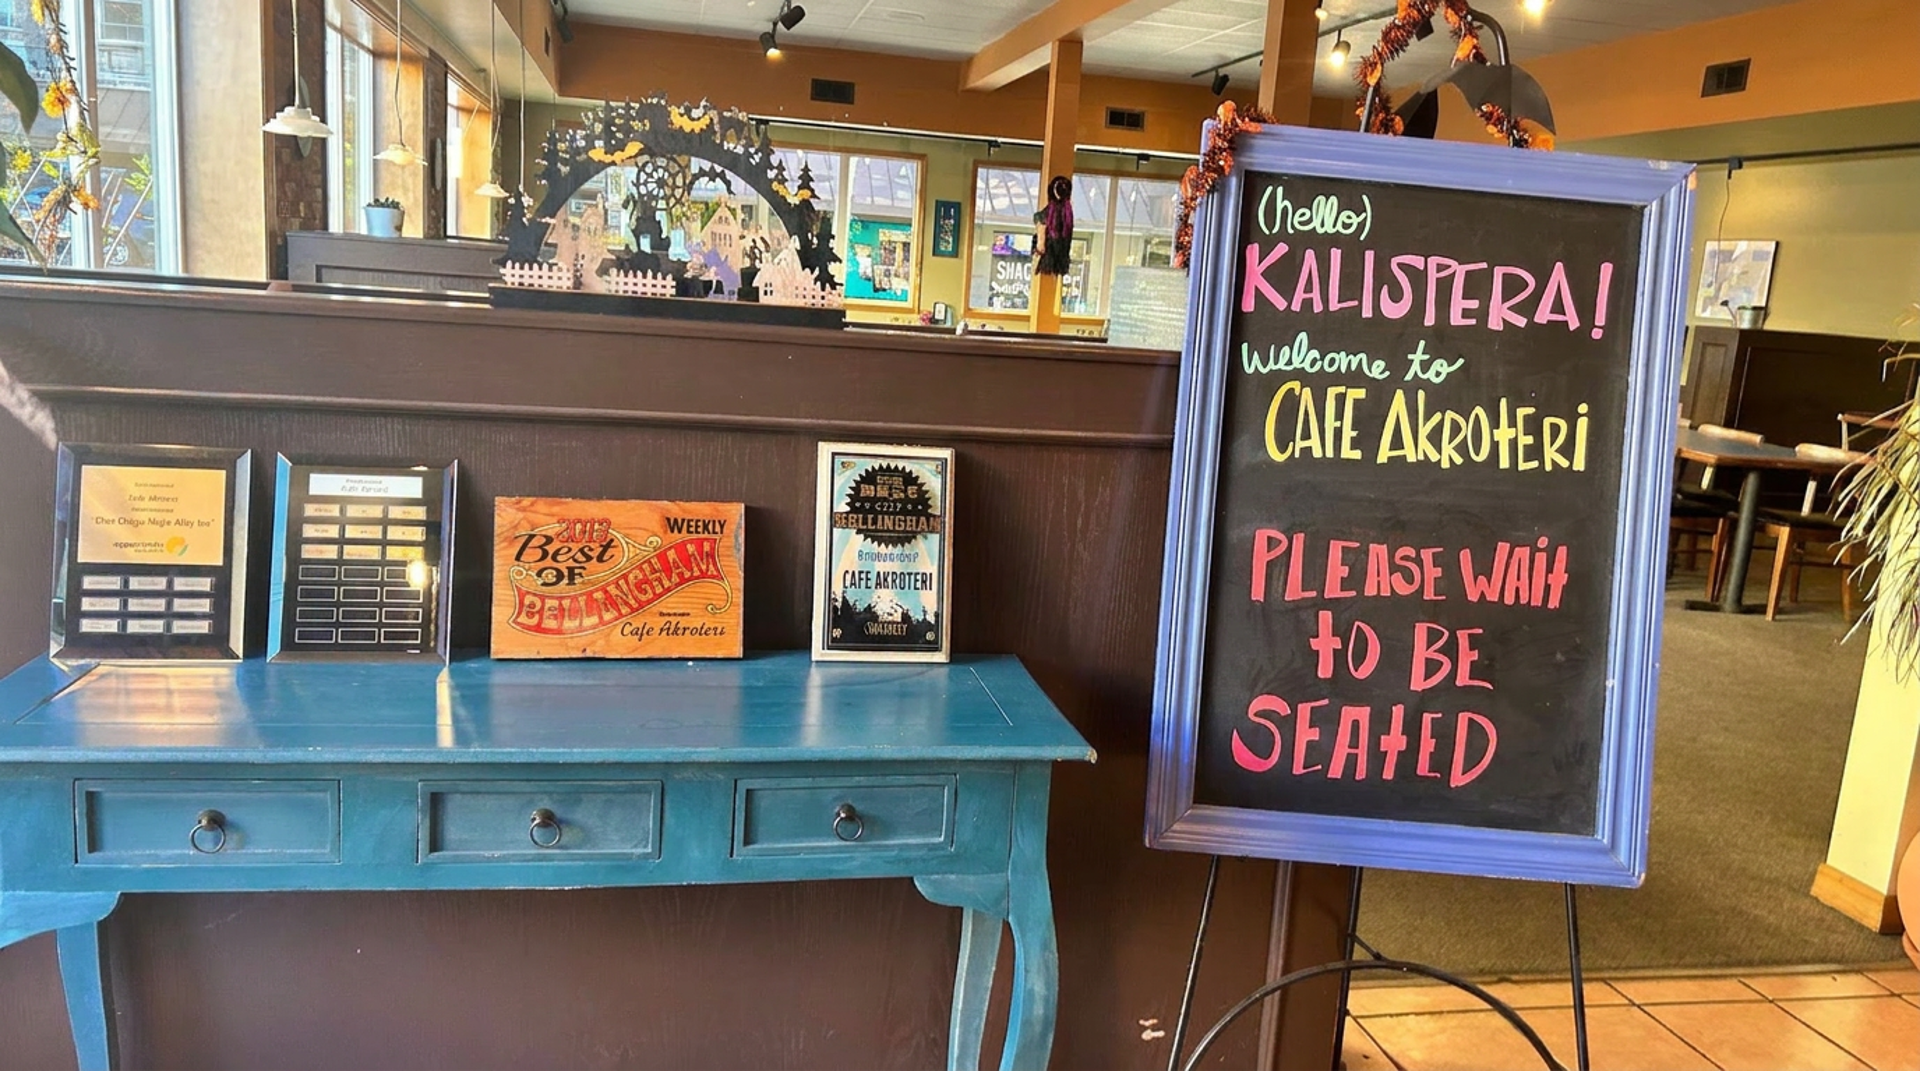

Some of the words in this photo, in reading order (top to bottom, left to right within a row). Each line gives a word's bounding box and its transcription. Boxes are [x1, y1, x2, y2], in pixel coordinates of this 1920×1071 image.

[1258, 186, 1372, 240] (hello)
[1241, 242, 1613, 339] KALISPERA!
[1241, 332, 1391, 380] welcome
[1404, 340, 1464, 384] to
[1265, 381, 1368, 462] CAFE
[514, 533, 615, 563] Best
[553, 518, 611, 543] 2013
[666, 517, 727, 535] WEEKLY
[517, 541, 718, 630] BELLINGHAM
[535, 566, 586, 588] OF
[843, 570, 871, 589] CAFE
[875, 571, 933, 591] AKROTERI
[1251, 529, 1446, 602] PLEASE
[620, 622, 655, 642] Cafe
[1410, 622, 1494, 691] BE
